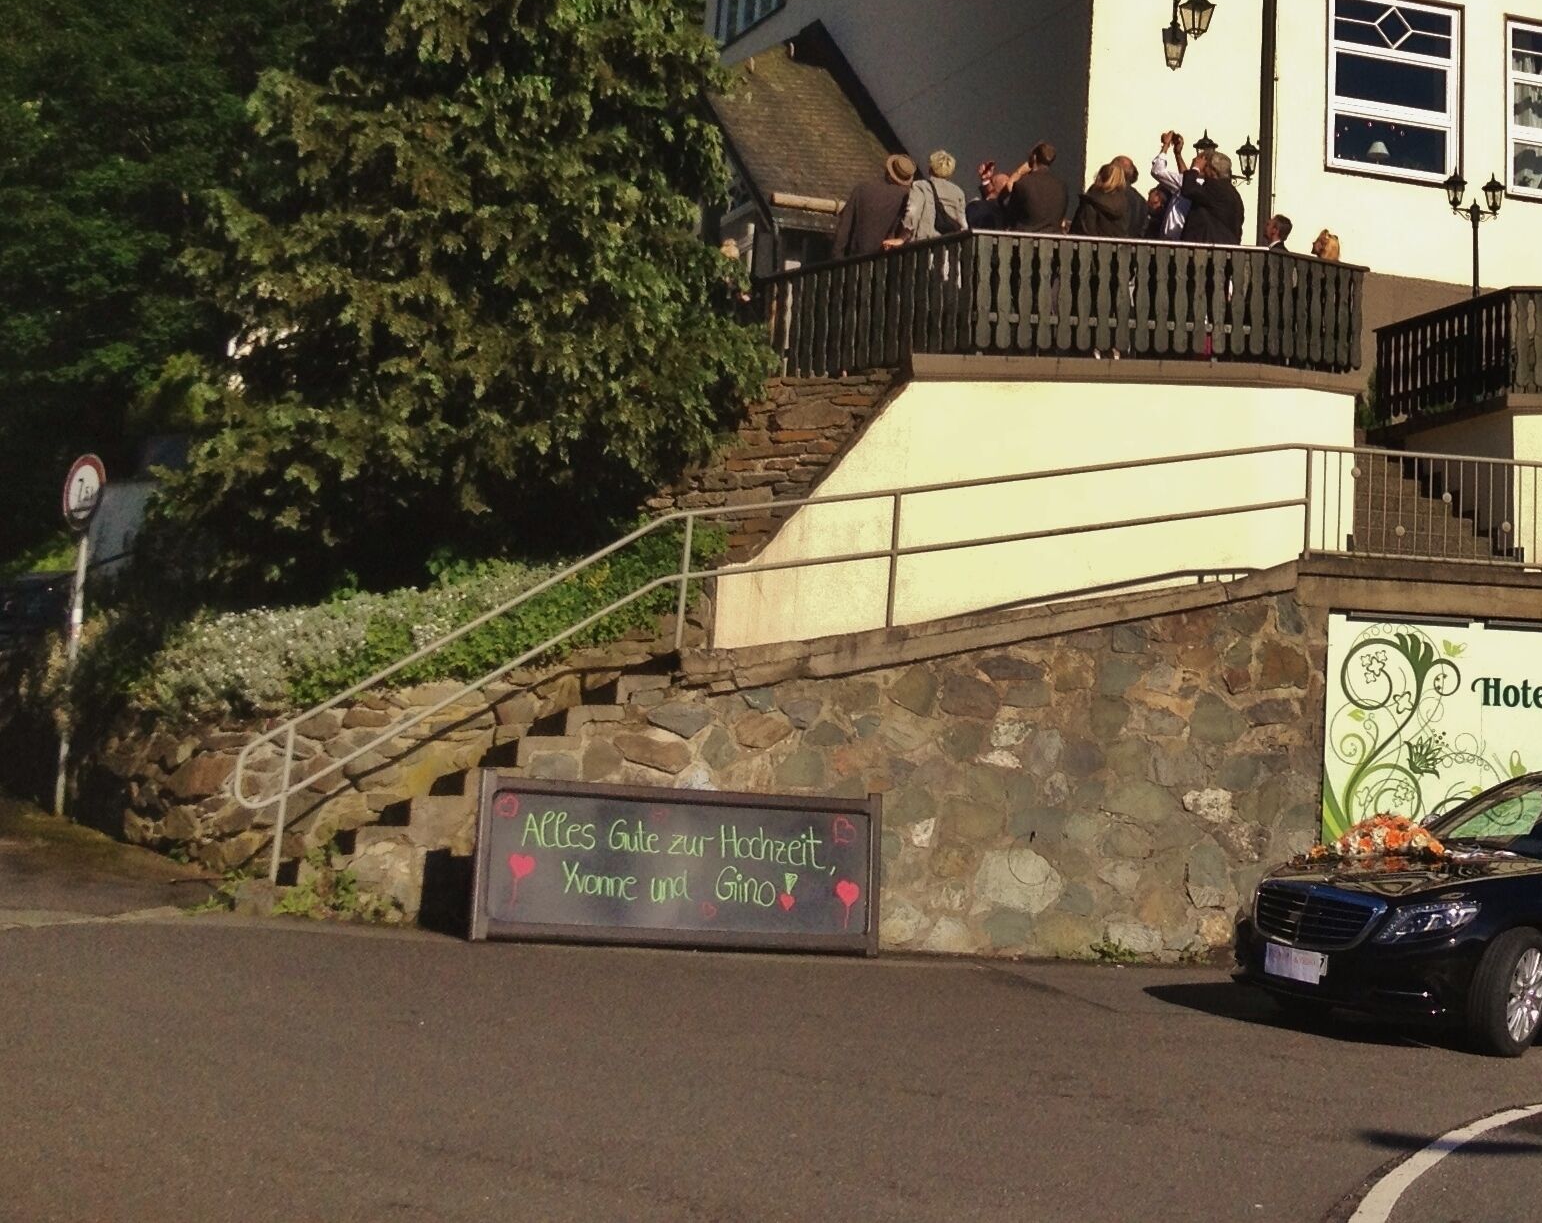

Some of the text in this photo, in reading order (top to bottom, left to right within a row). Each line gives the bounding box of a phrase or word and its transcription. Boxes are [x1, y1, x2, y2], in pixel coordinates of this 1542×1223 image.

[521, 810, 596, 850] Alles
[608, 819, 661, 854] Gute
[667, 833, 714, 858] zur
[562, 860, 639, 901] Yvonne
[651, 870, 693, 904] und
